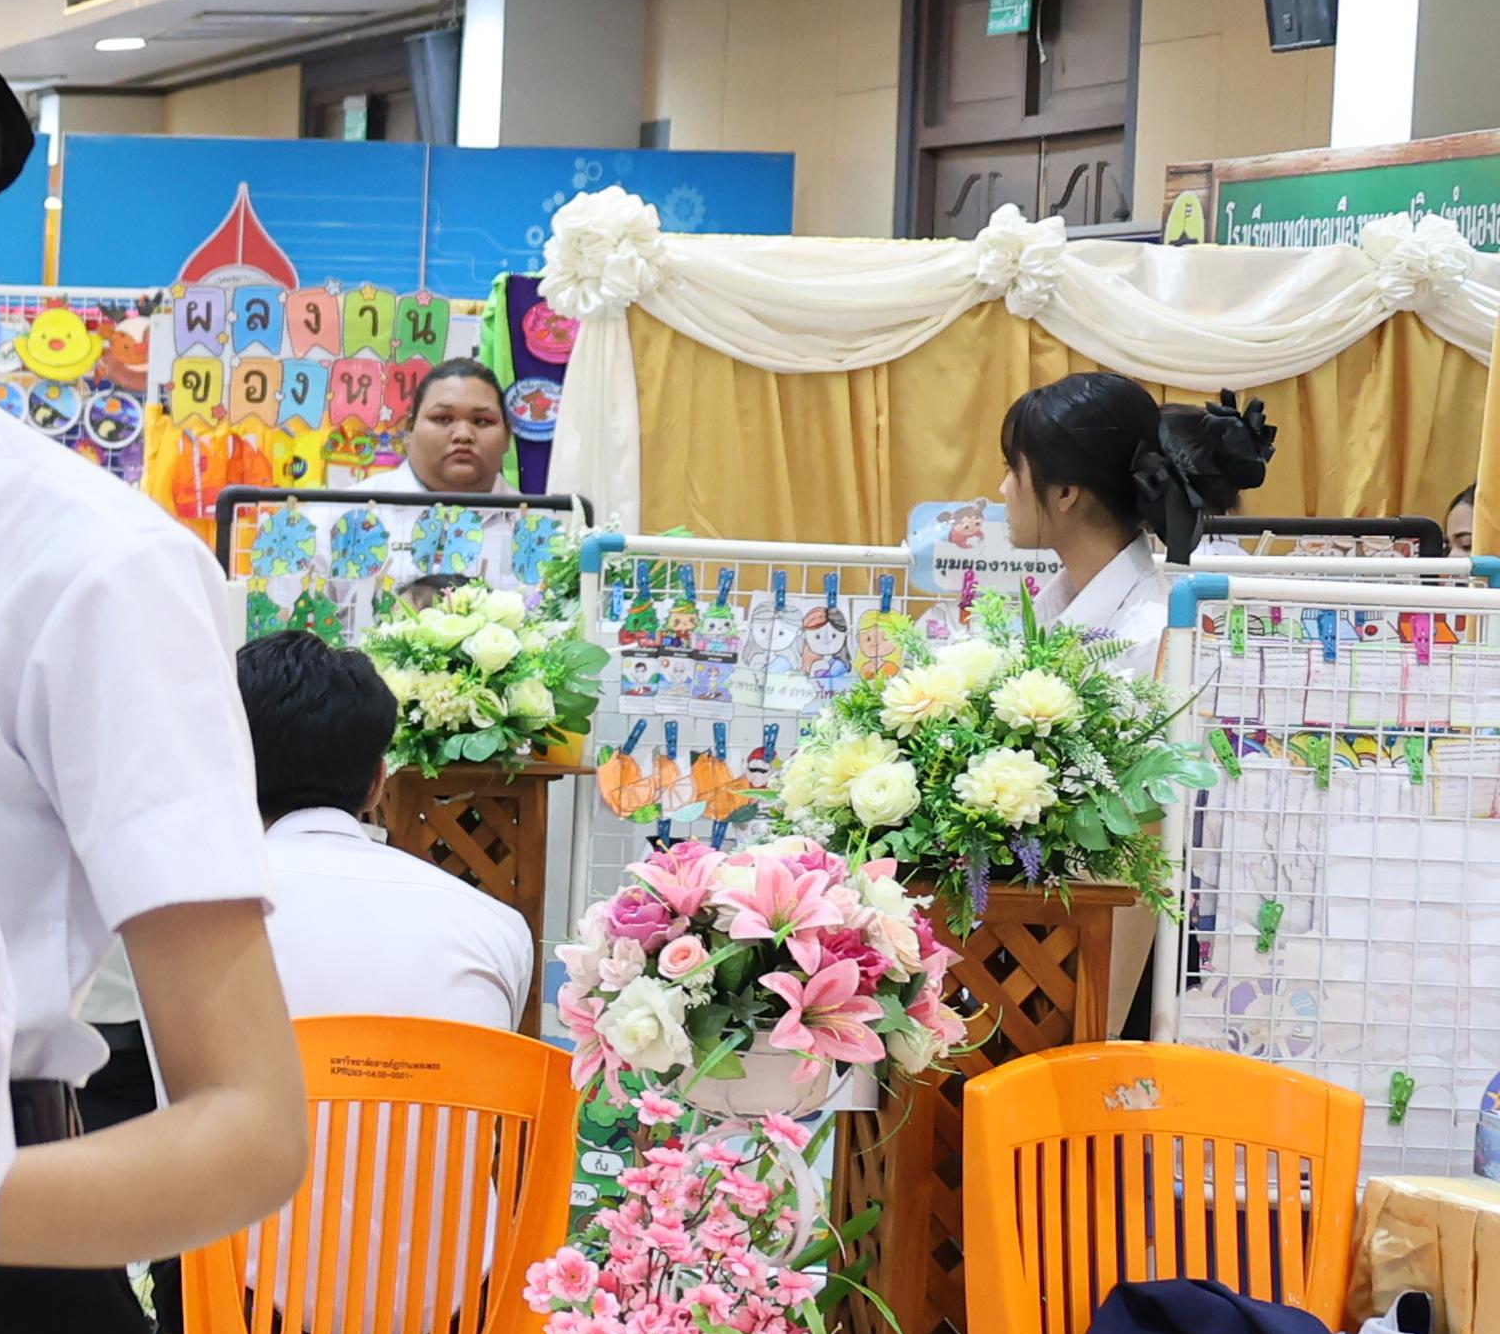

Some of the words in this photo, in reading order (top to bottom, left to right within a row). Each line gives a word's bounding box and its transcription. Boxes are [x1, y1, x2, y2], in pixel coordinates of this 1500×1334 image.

[186, 297, 437, 345] ผลงาน
[934, 557, 1067, 577] มุมผลงานของ
[572, 1190, 587, 1200] าก
